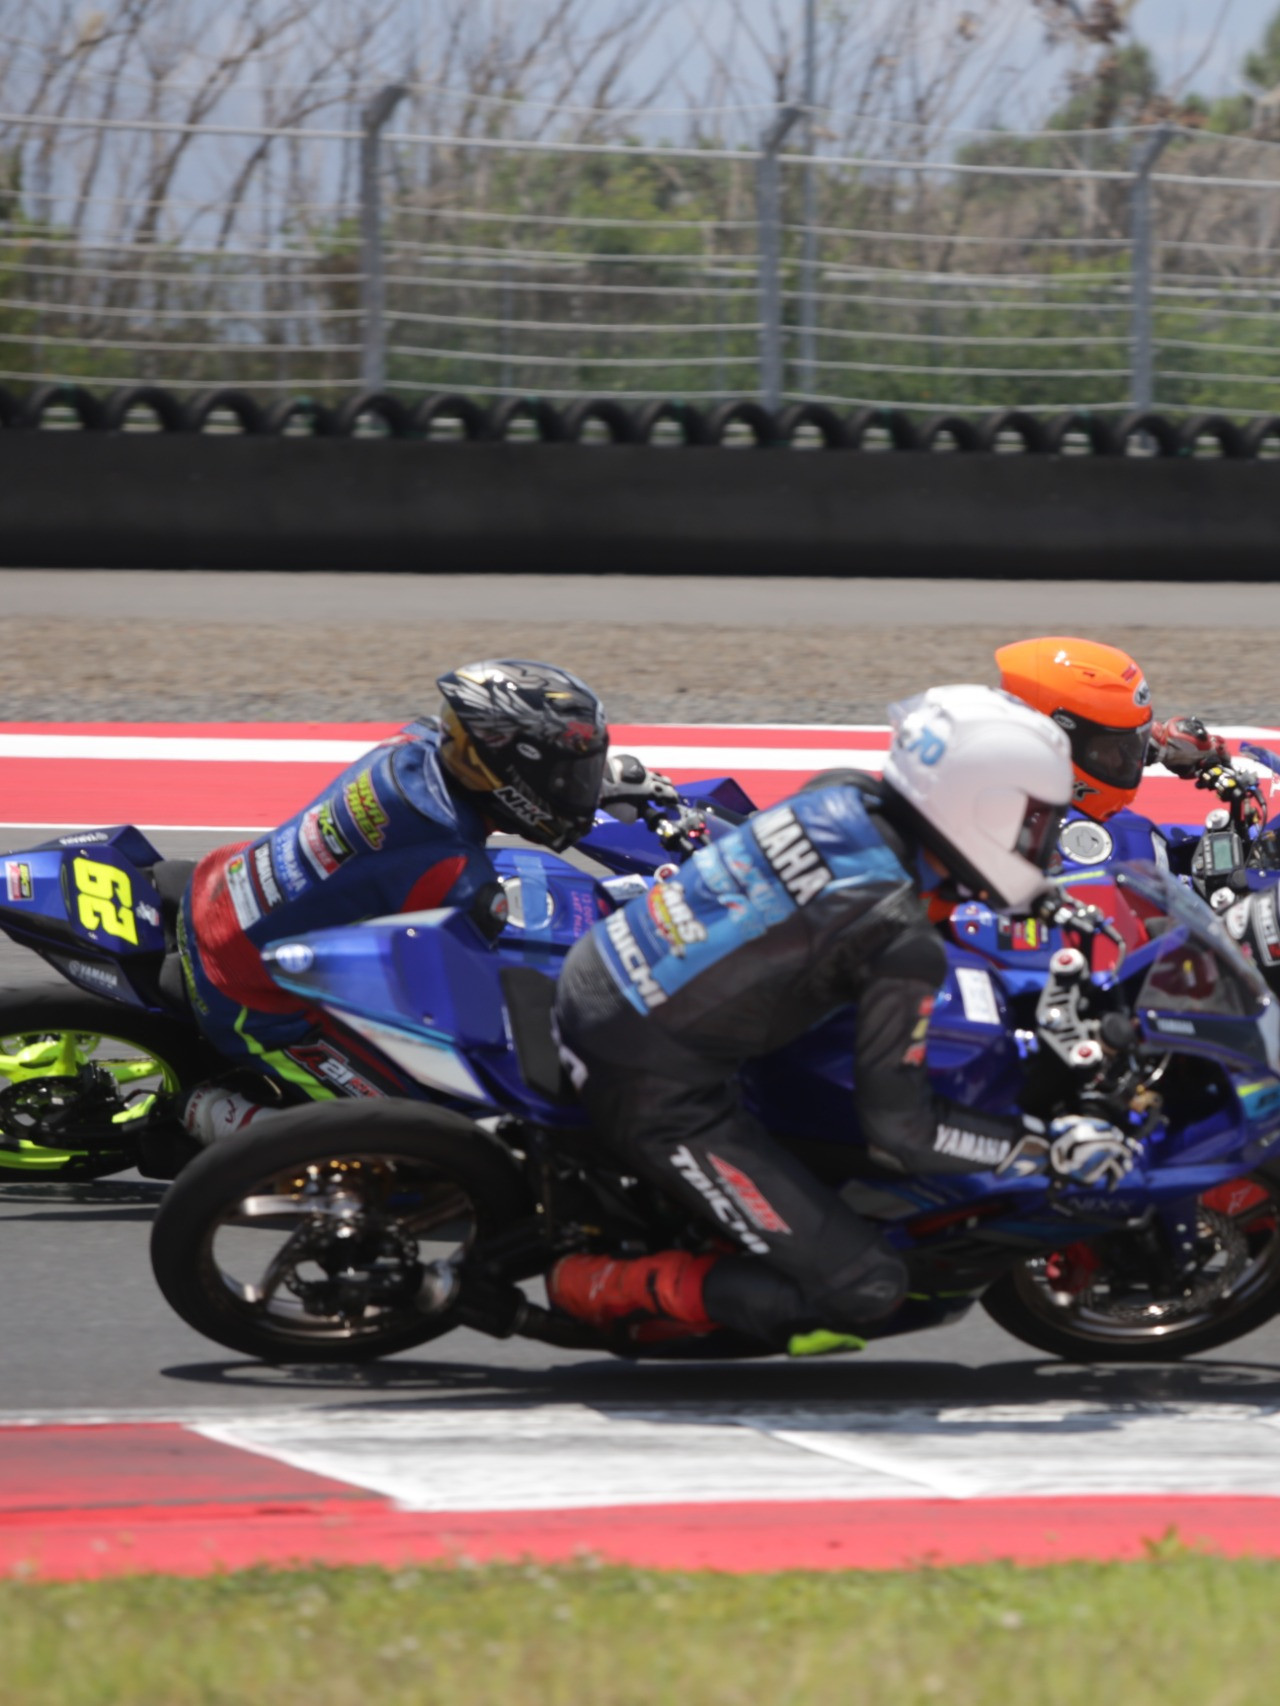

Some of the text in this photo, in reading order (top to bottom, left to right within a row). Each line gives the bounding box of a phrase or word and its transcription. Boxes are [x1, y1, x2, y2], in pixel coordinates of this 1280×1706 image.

[495, 786, 553, 826] NHK
[80, 963, 117, 987] YAMAHA
[934, 1123, 1011, 1166] YAMAHA
